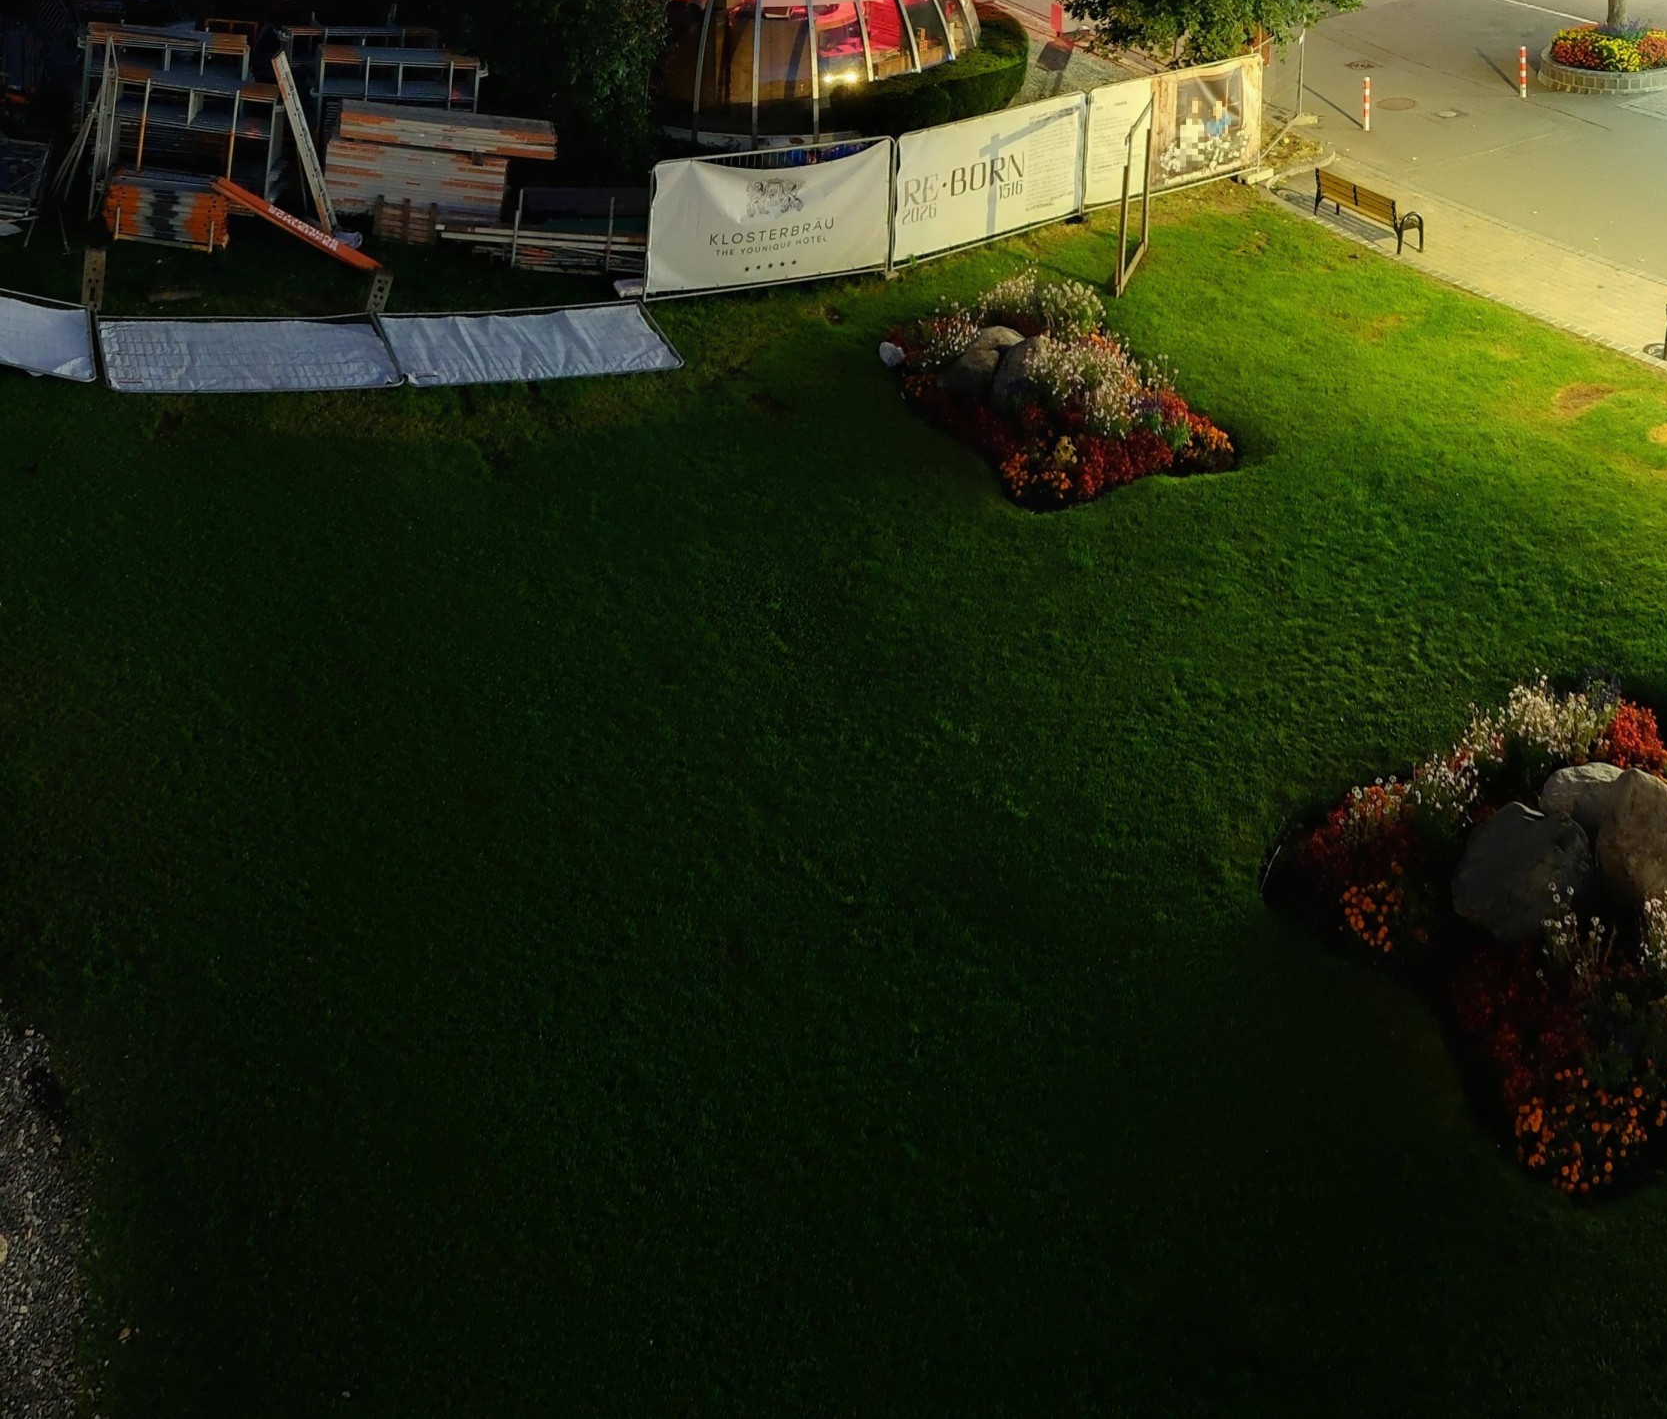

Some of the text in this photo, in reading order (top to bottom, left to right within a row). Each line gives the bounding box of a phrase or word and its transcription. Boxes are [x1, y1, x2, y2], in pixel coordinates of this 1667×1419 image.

[999, 179, 1024, 201] 1516
[902, 202, 937, 226] 2026
[709, 216, 835, 246] KLOSTERBRÄU
[716, 234, 828, 257] THE YOUNIQUE HOTEL
